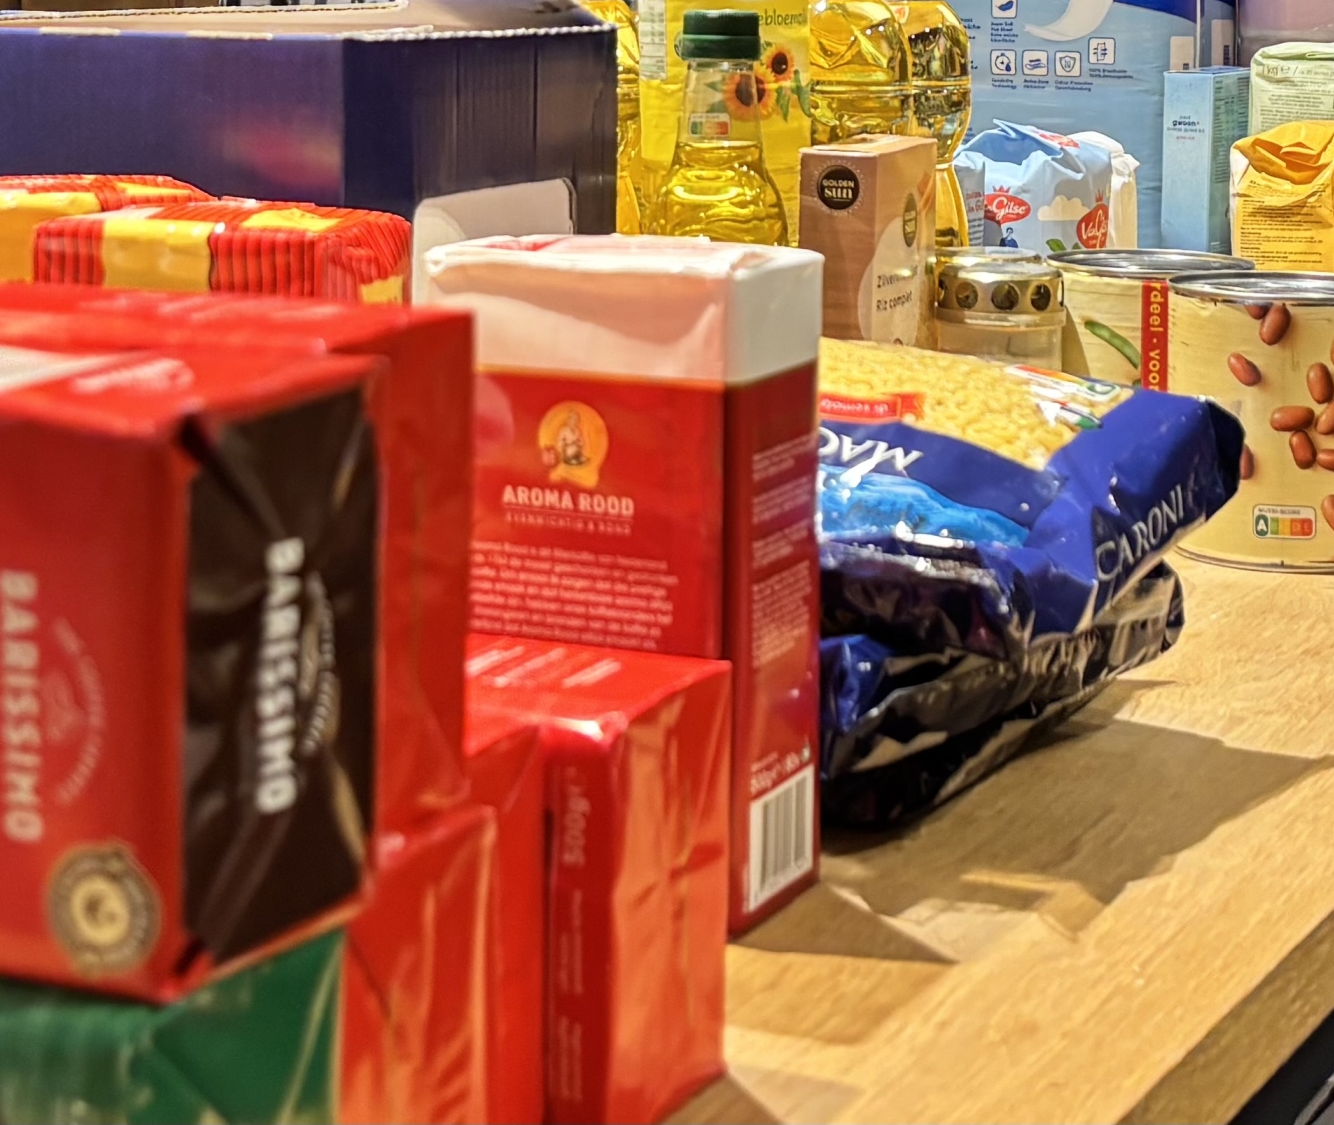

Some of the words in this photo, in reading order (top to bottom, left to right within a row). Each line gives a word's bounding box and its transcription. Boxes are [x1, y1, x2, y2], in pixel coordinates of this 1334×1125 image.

[821, 178, 855, 188] GOLDEN
[824, 187, 853, 200] sun
[1149, 282, 1165, 332] rdeel
[1148, 349, 1161, 391] voor
[501, 484, 575, 511] AROMA
[578, 492, 635, 518] ROOD
[255, 536, 306, 815] BARISSIMO
